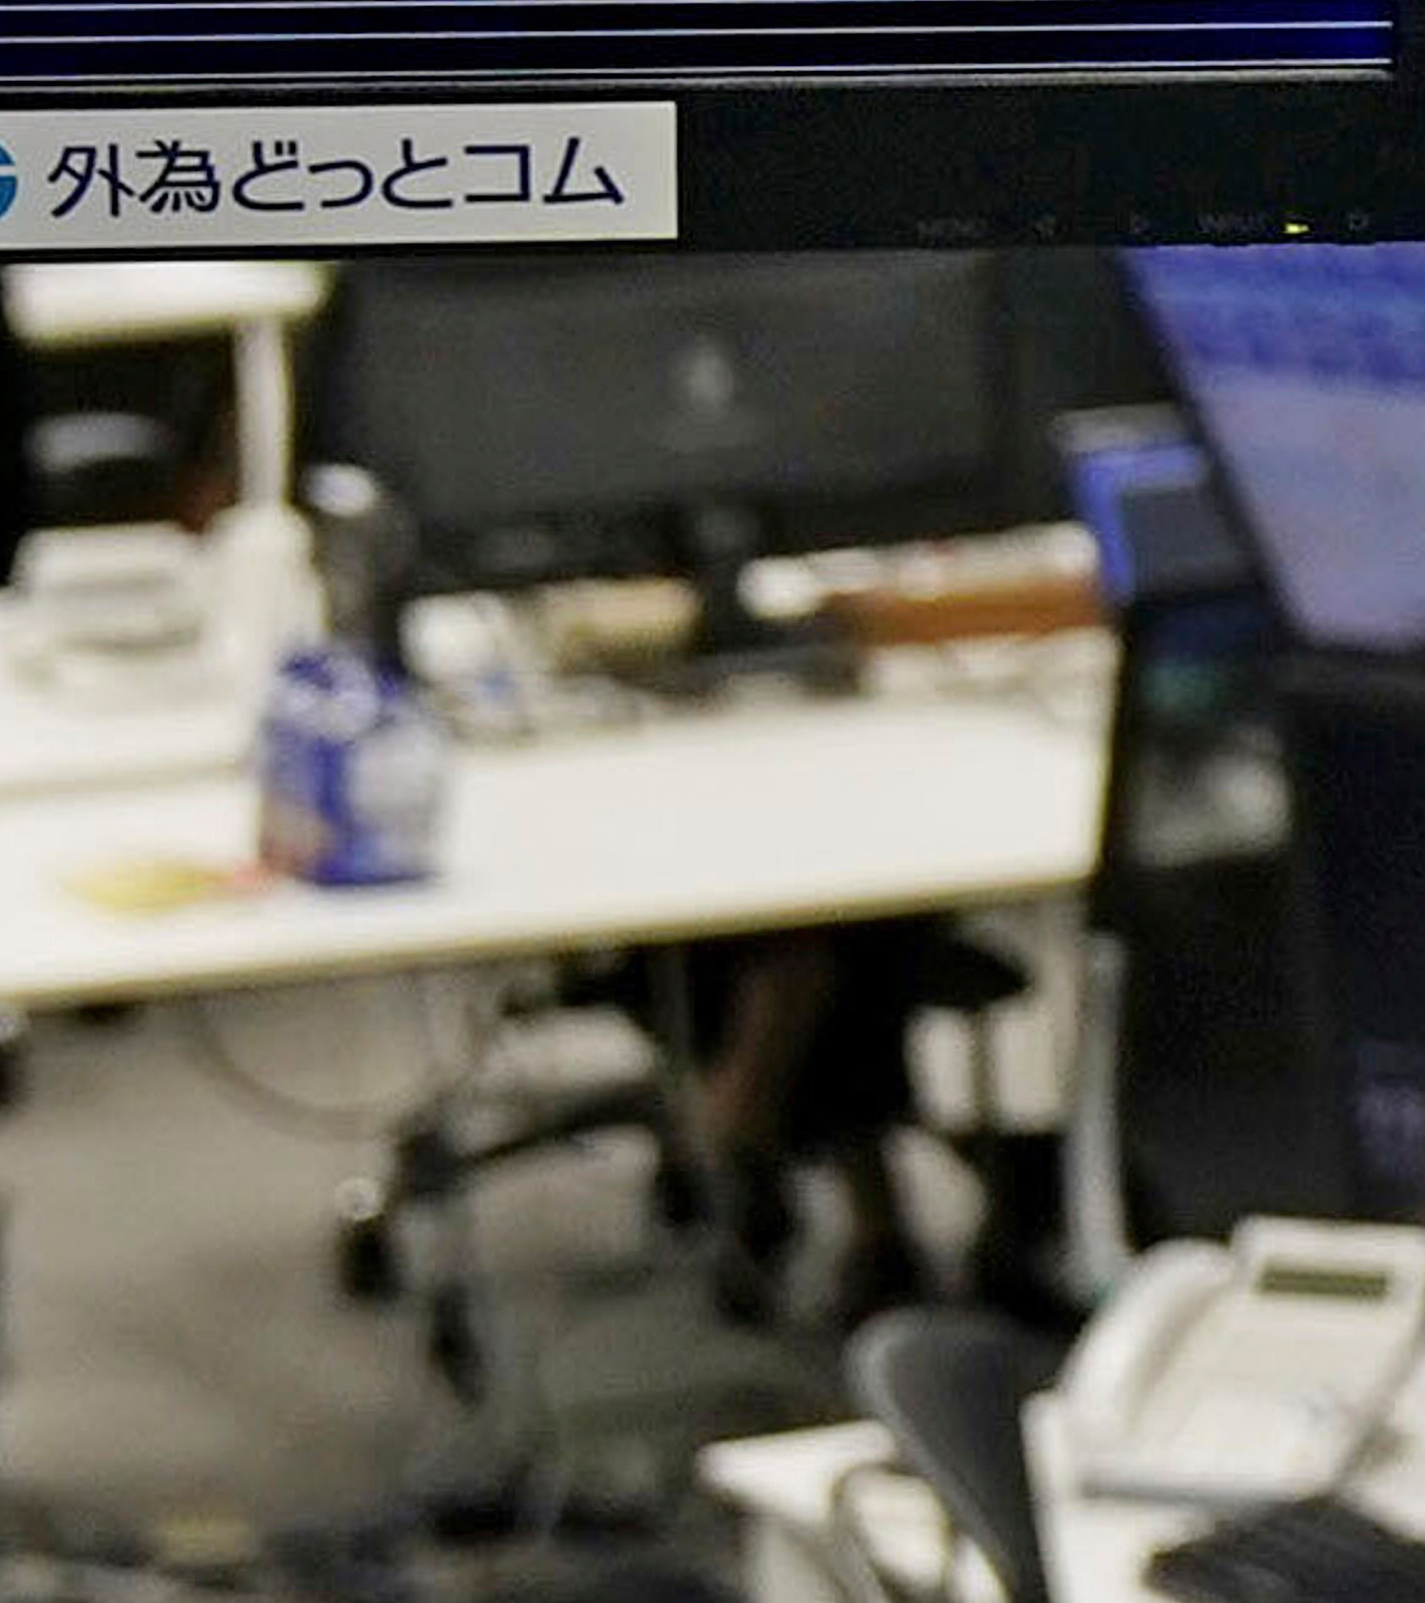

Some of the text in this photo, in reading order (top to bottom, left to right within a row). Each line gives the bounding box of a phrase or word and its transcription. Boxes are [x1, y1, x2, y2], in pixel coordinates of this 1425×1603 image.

[47, 137, 625, 218] 外為どっとコム
